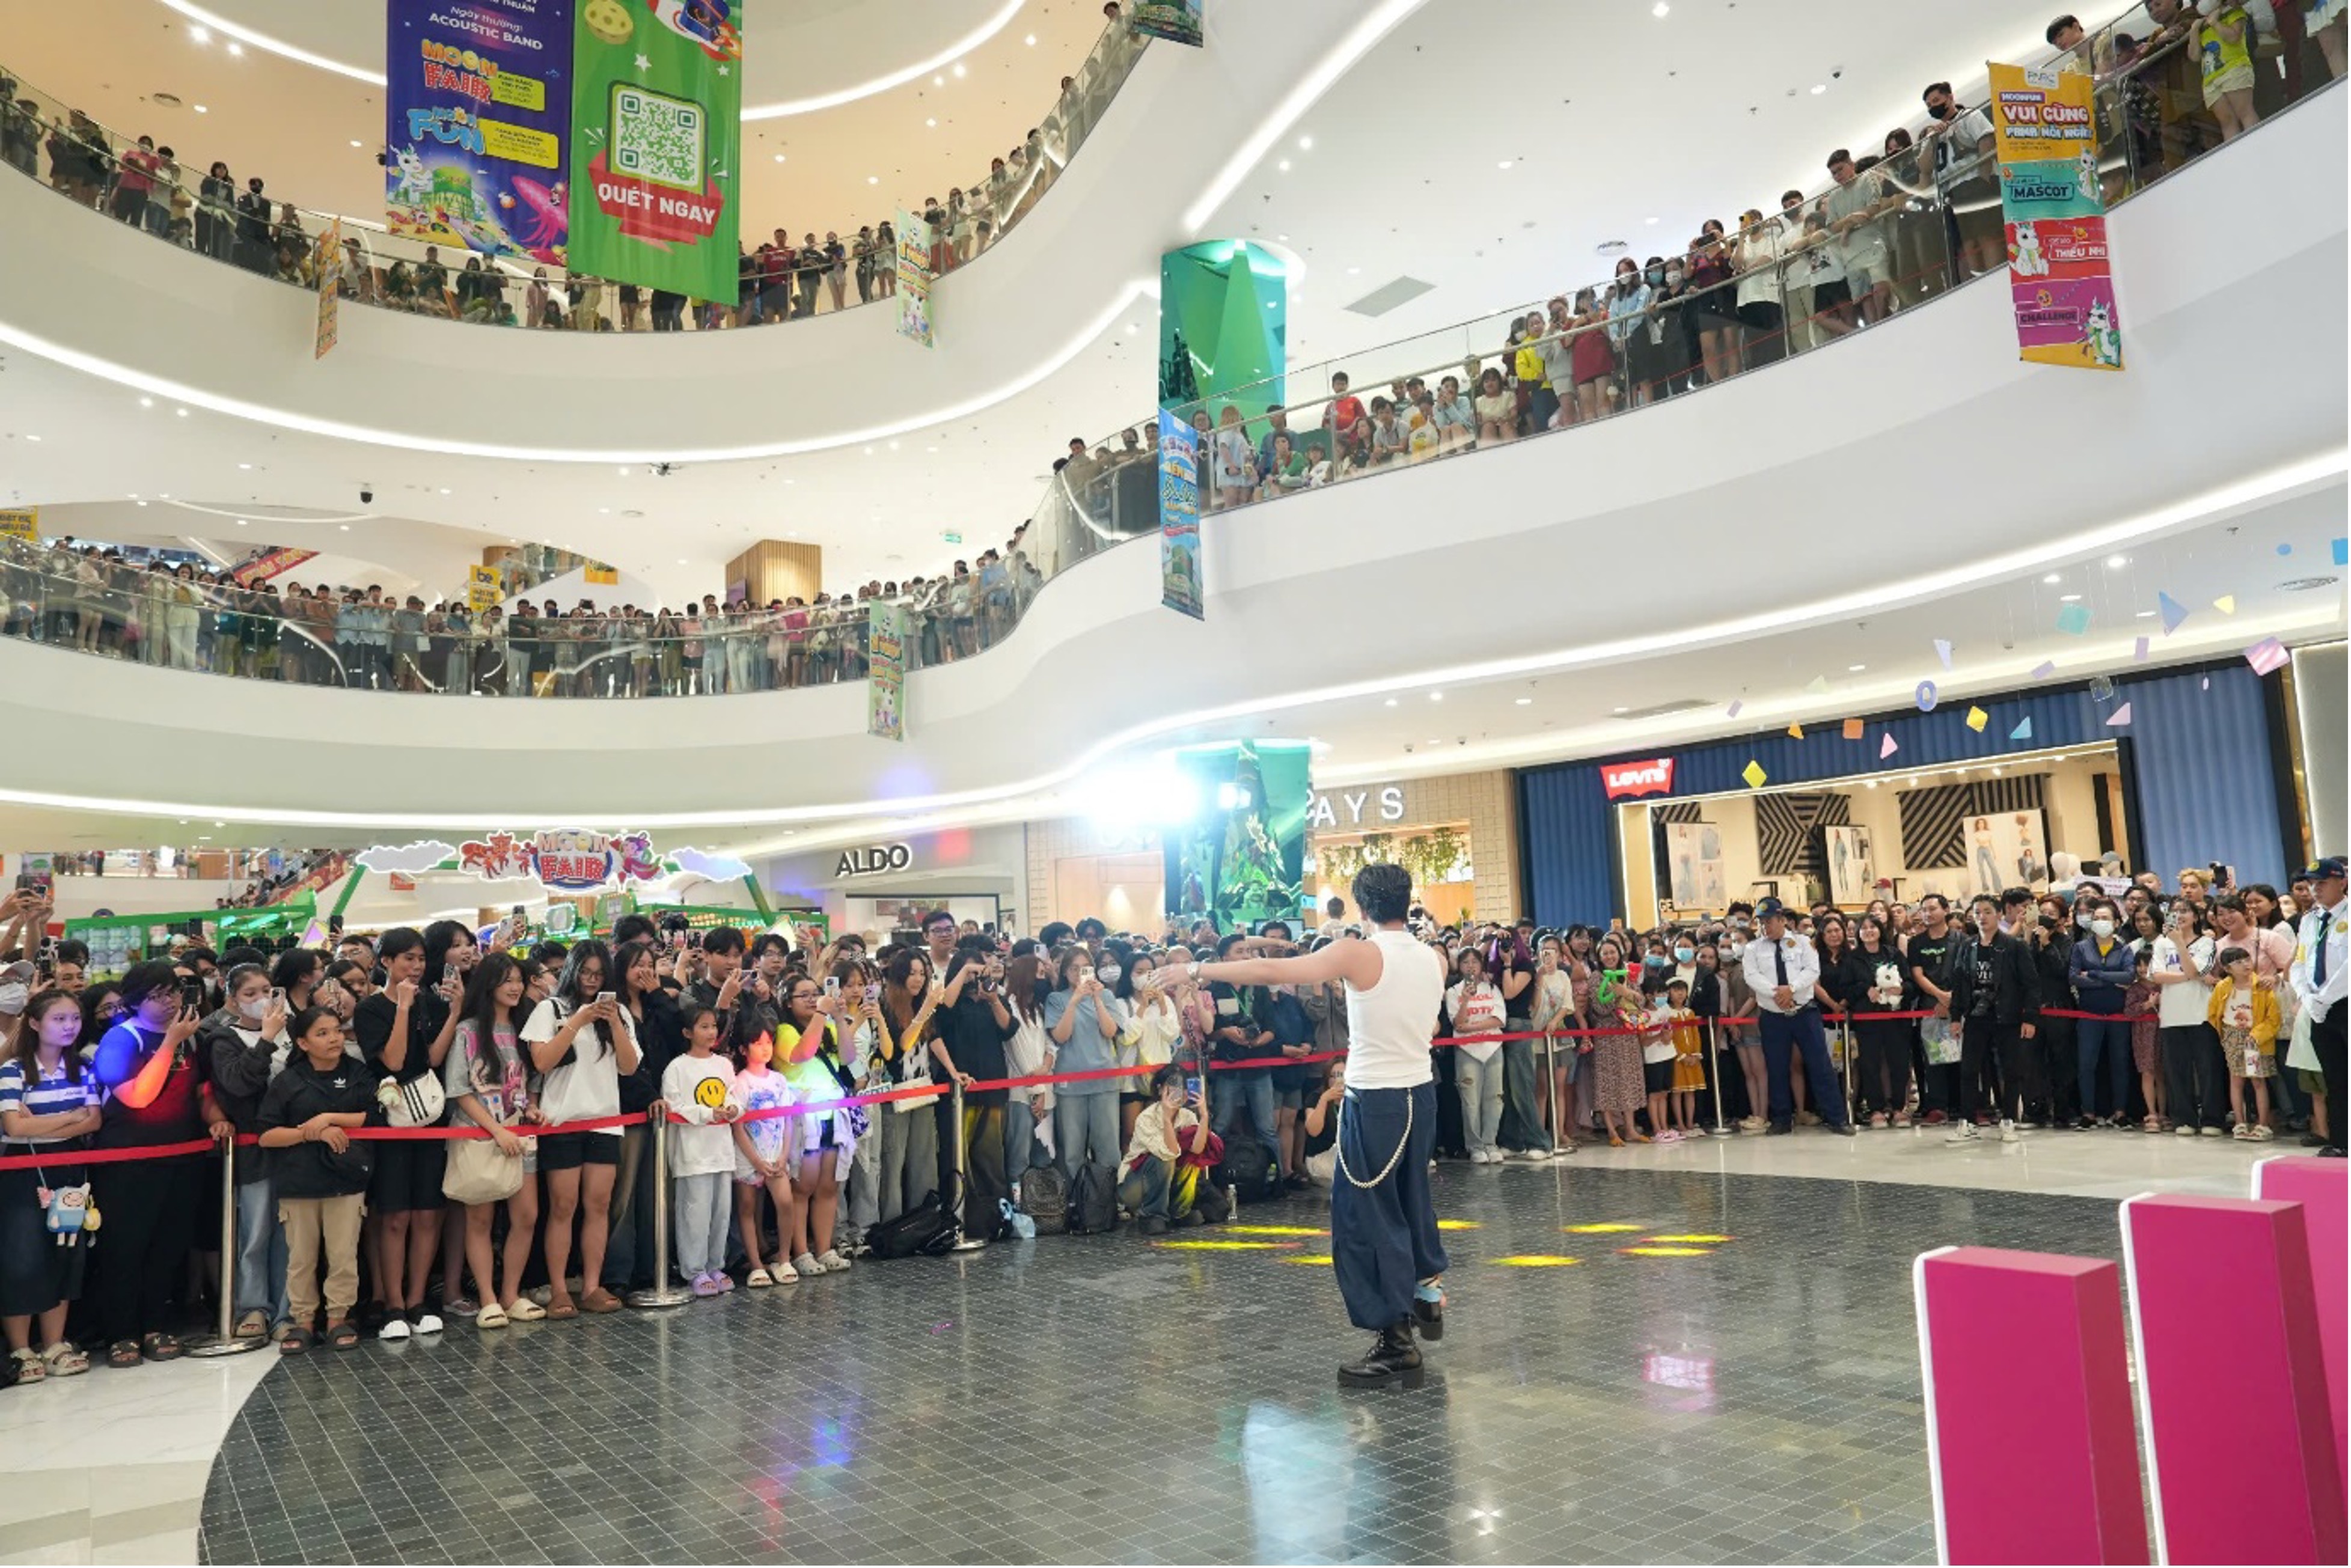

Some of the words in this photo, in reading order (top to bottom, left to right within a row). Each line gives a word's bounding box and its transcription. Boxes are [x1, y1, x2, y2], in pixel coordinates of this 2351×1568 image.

[429, 13, 499, 38] ACOUSTIC
[503, 31, 543, 50] BAND
[422, 38, 498, 78] MOON
[424, 61, 491, 105] FAIR
[2002, 104, 2038, 121] VUI
[2043, 102, 2089, 123] CÙNG
[406, 108, 485, 156] FUN
[598, 183, 654, 210] QUÉT
[659, 197, 715, 225] NGAY
[2014, 186, 2068, 199] MASCOT
[2021, 312, 2076, 323] CHALLENGE
[538, 832, 610, 852] MOON
[540, 856, 605, 882] FAIR
[835, 844, 910, 877] ALDO
